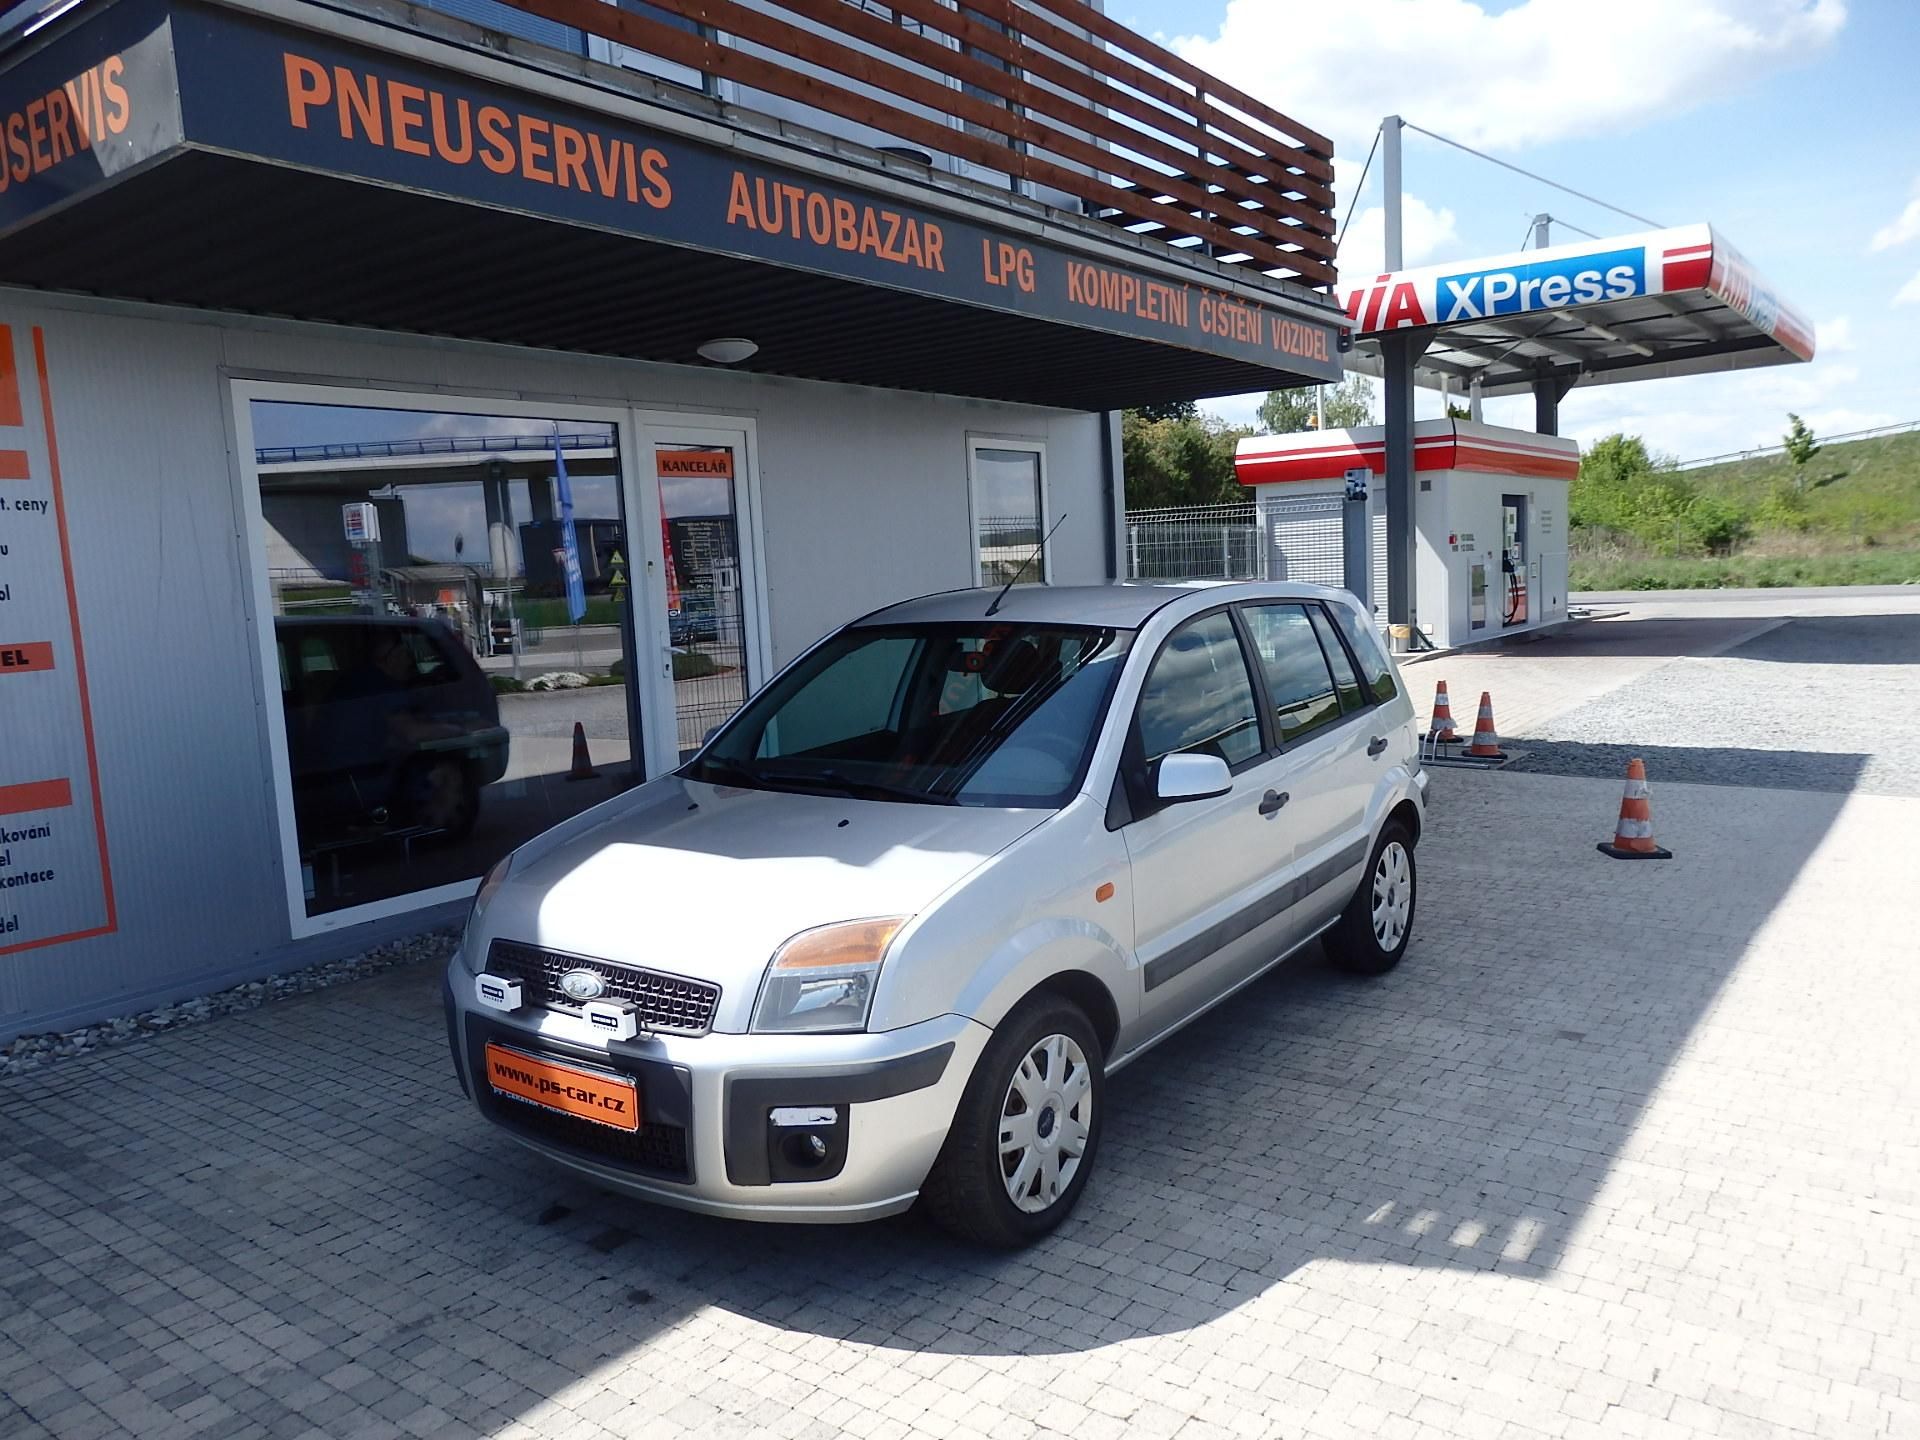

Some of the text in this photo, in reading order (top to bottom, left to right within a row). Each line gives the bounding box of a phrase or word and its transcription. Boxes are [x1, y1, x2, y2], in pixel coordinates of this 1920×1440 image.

[283, 52, 1329, 362] PNEUSERVIS AUTOBAZAR LPG KOMPLETNÍ ČIŠTĚNÍ VOZIDEL
[1445, 265, 1637, 321] XPress
[662, 460, 727, 473] KANCELÁŘ
[15, 500, 48, 515] ceny
[0, 822, 51, 844] kování
[493, 1061, 626, 1114] www.ps-car.cz
